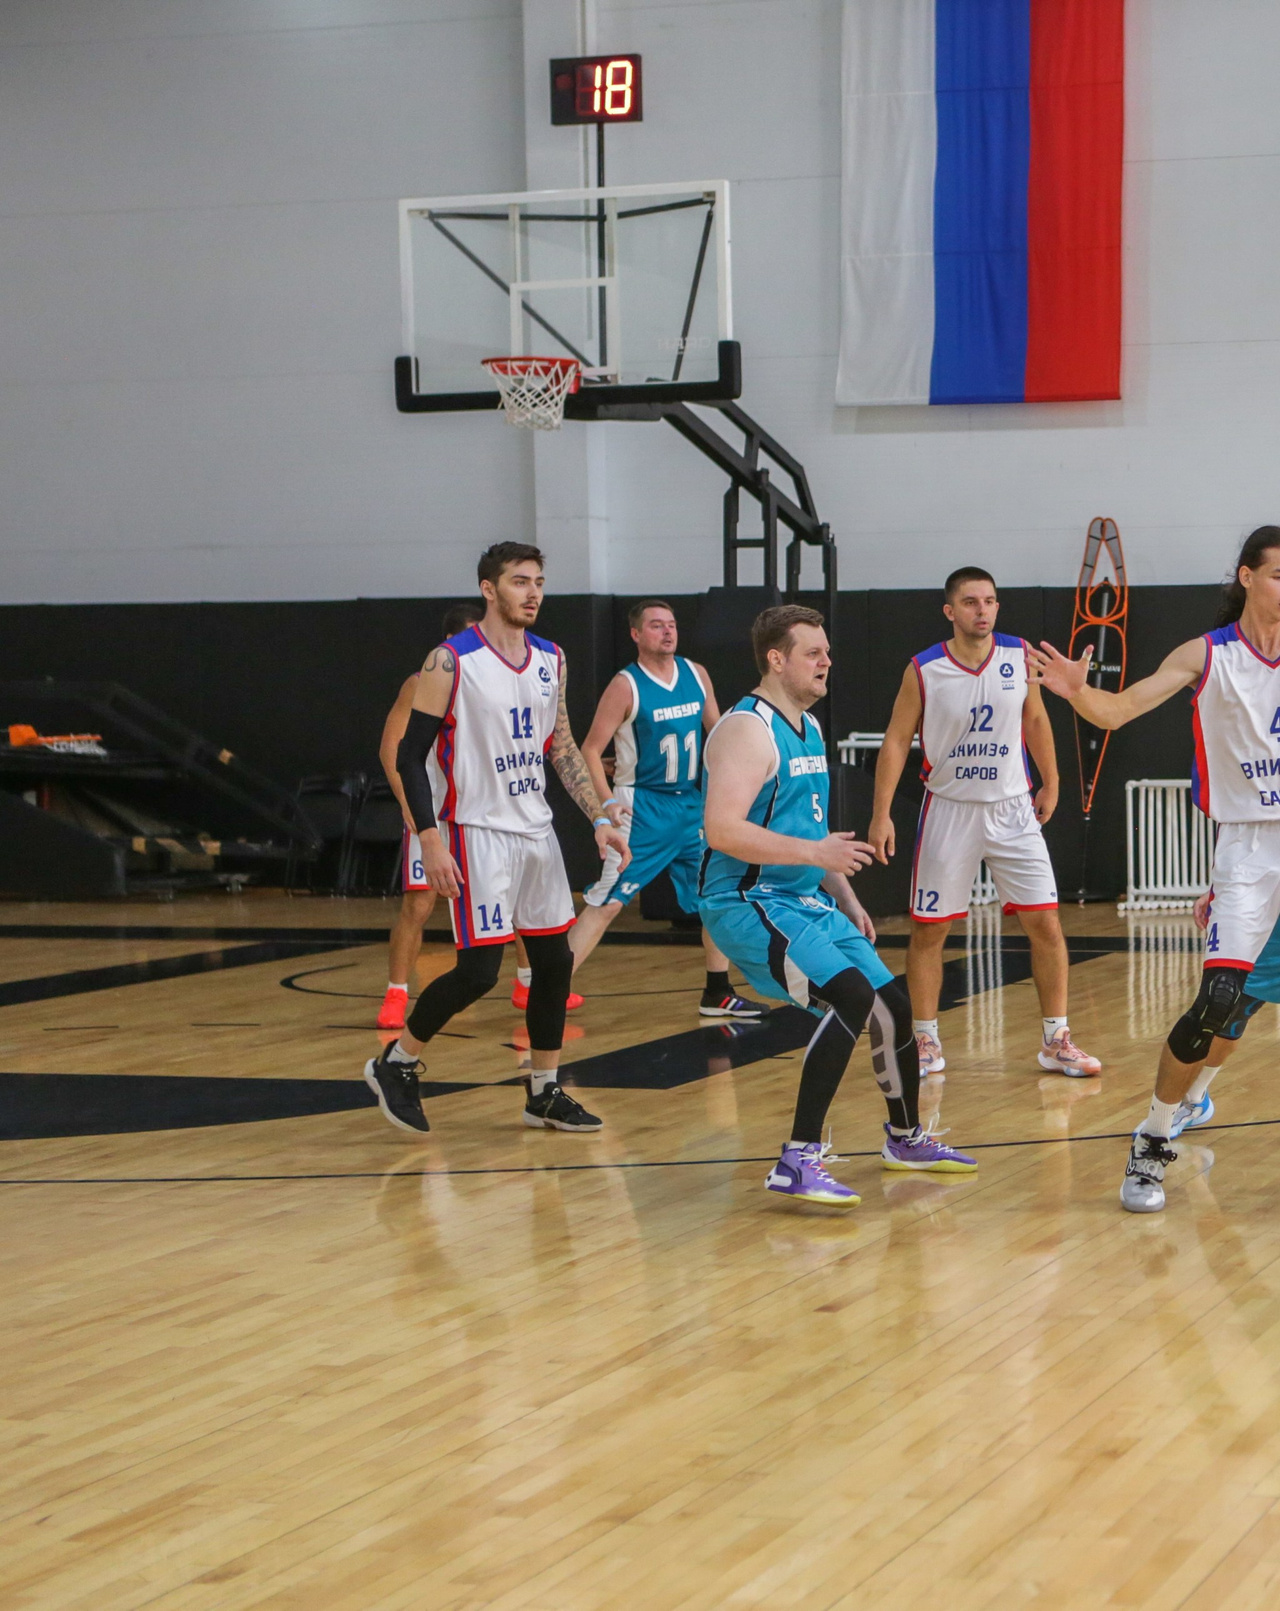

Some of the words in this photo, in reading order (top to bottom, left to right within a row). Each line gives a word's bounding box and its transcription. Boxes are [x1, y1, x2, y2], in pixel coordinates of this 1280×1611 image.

[593, 60, 633, 115] 18
[509, 706, 533, 740] 14
[653, 701, 701, 723] СИБУР
[969, 704, 993, 733] 12
[659, 730, 698, 783] 11
[508, 777, 540, 797] САРО
[955, 766, 998, 780] САРОВ
[811, 792, 824, 824] 5
[916, 888, 940, 912] 12
[477, 903, 504, 932] 14
[1207, 922, 1220, 953] 4
